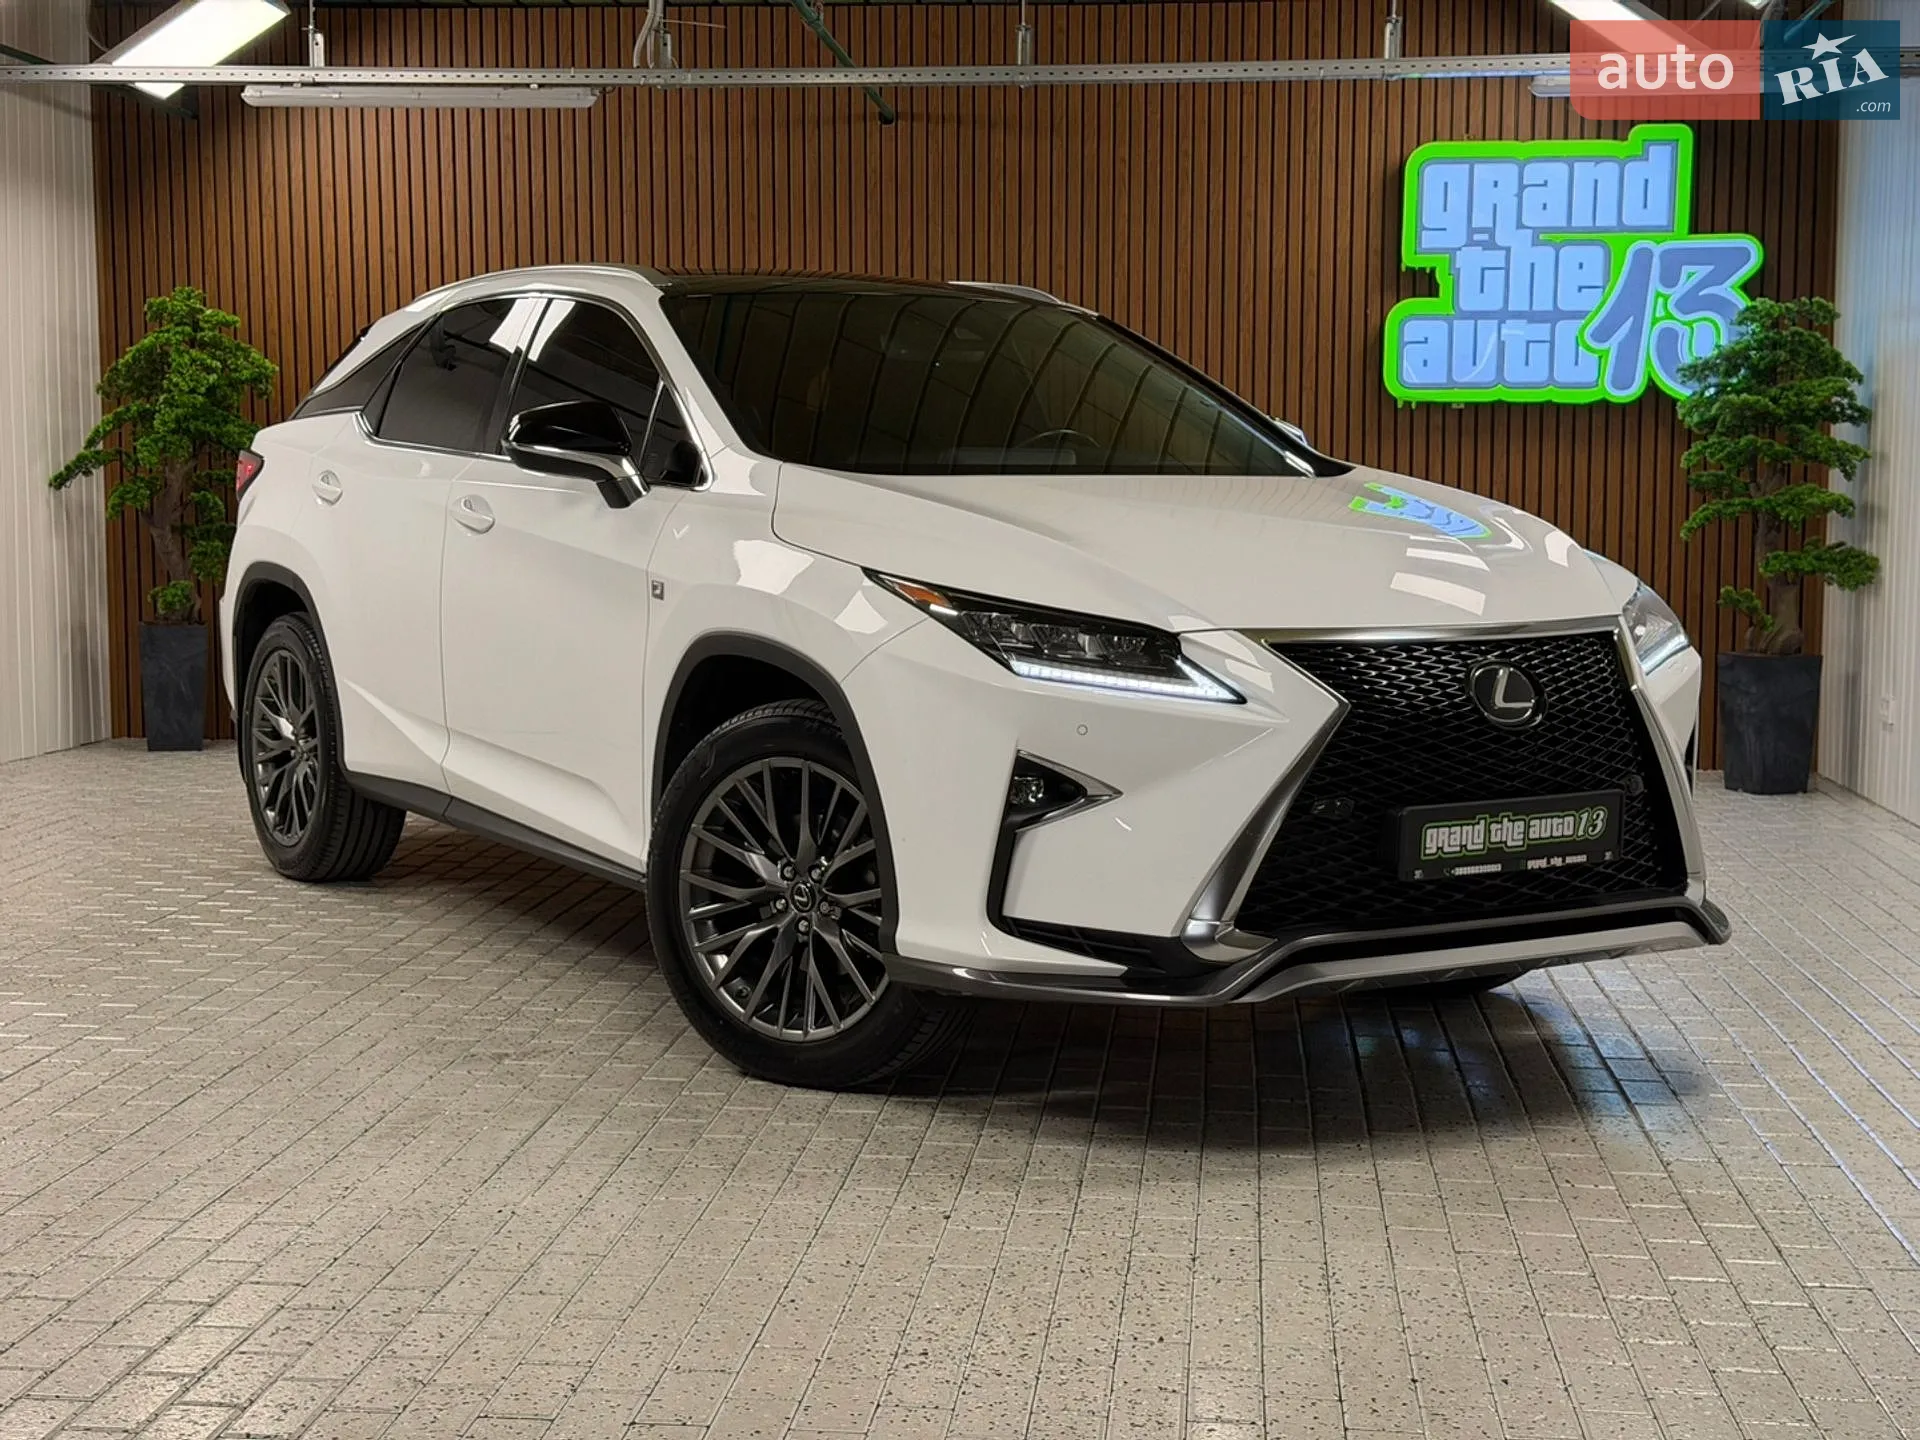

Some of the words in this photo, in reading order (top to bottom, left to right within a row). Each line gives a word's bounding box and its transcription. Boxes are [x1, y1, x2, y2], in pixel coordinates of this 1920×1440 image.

[1420, 143, 1674, 249] grand
[1455, 229, 1605, 311] the
[1402, 319, 1600, 384] auto
[1586, 241, 1755, 397] 13
[1425, 819, 1485, 854] grand
[1490, 817, 1526, 846] the
[1528, 815, 1575, 839] auto
[1576, 808, 1606, 837] 13
